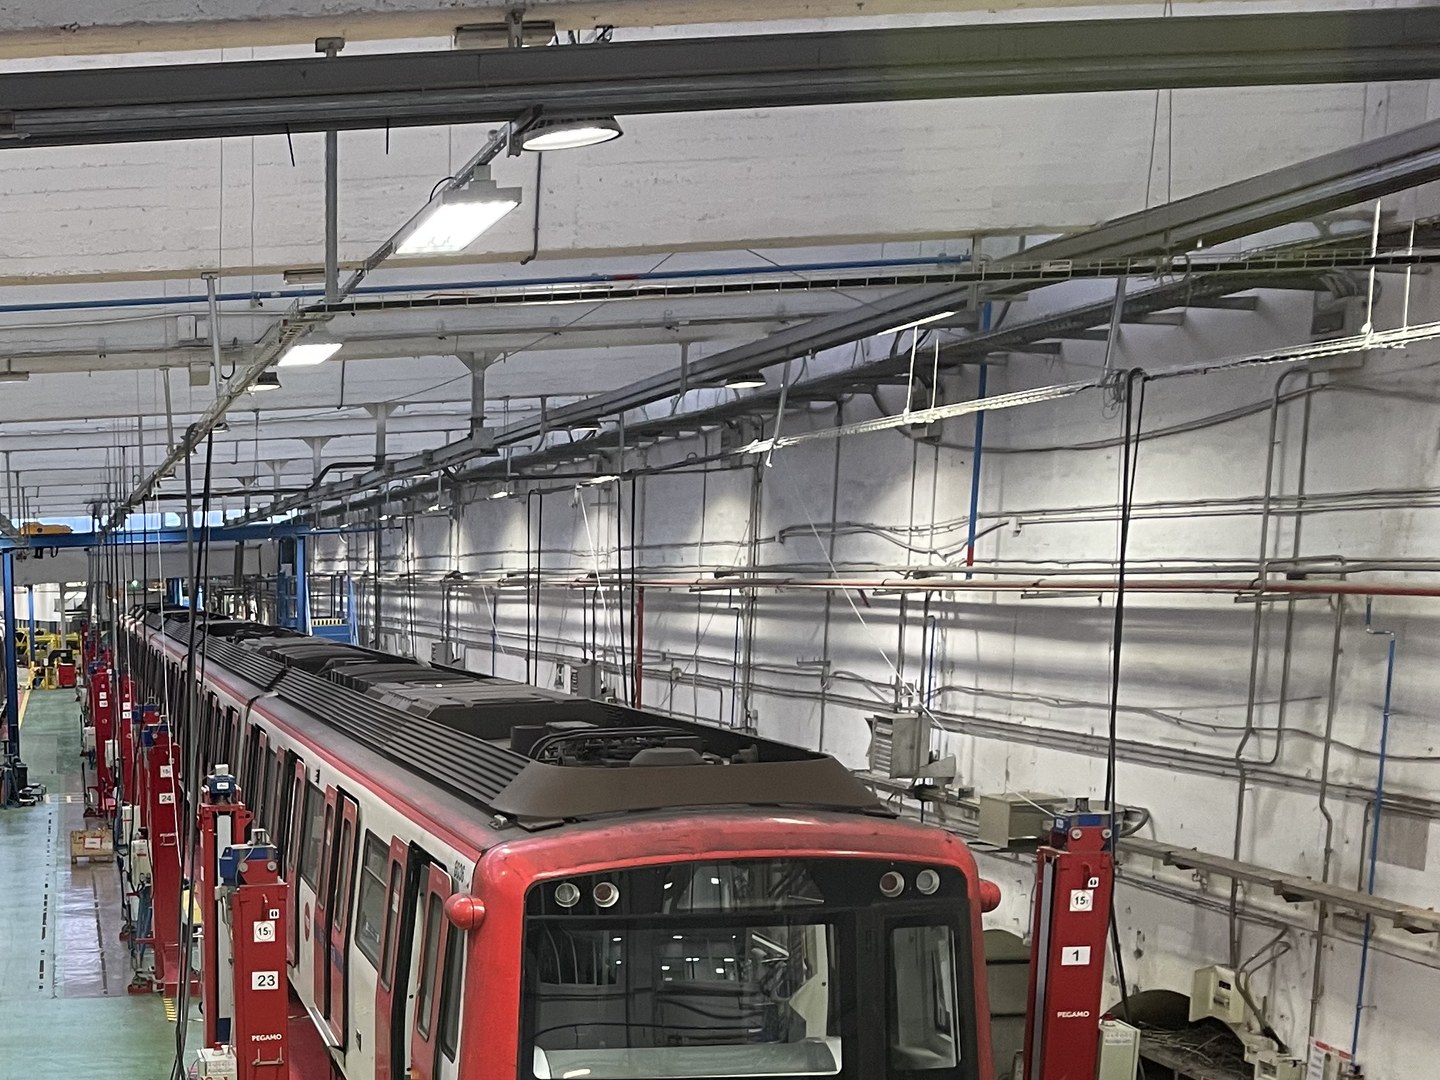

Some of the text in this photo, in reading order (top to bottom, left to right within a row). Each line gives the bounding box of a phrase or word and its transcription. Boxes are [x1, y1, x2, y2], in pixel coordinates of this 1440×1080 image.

[1072, 950, 1080, 961] 1
[257, 974, 276, 987] 23
[1057, 1010, 1090, 1018] PEGAMO
[251, 1033, 282, 1042] PEGAMO
